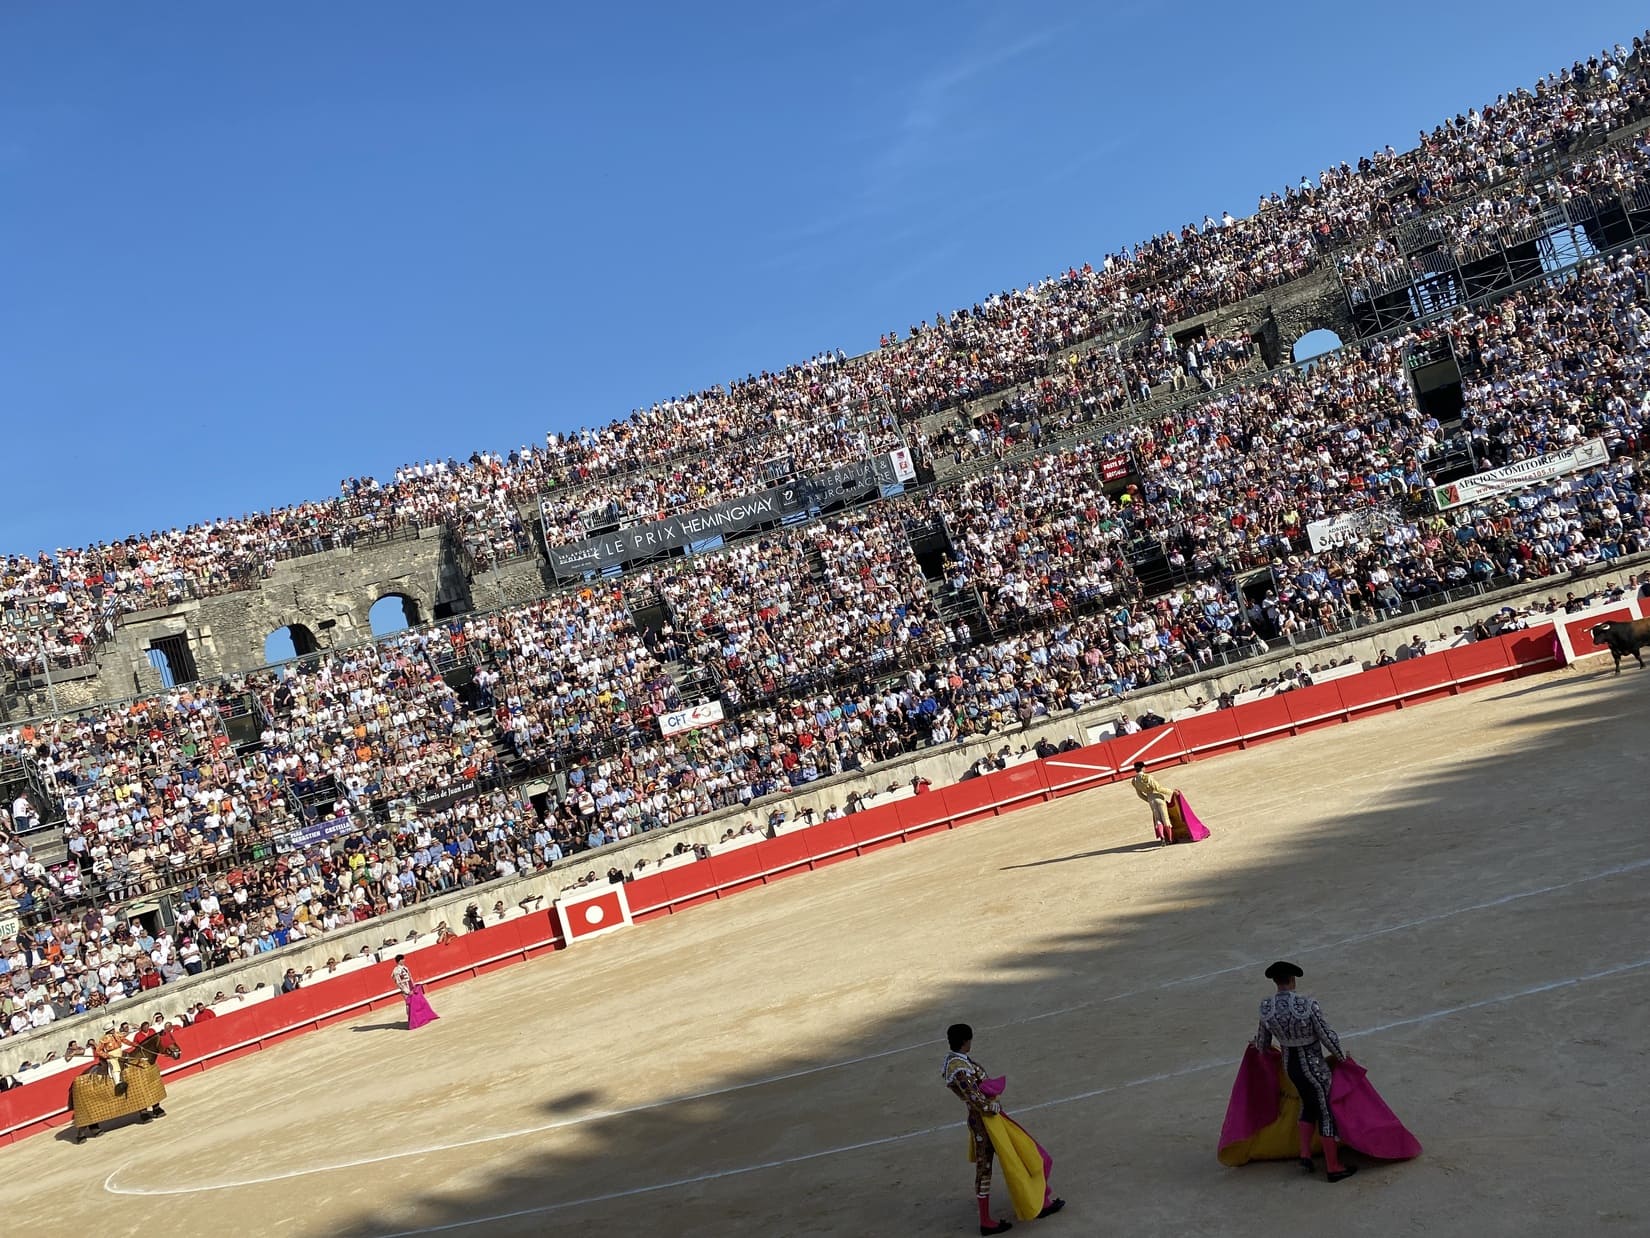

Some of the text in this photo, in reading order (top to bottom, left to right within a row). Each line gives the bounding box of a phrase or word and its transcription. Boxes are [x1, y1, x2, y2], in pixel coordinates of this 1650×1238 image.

[1499, 454, 1556, 477] VOMITOIRE
[606, 497, 773, 556] LE PRIX HEMINGWAY
[440, 789, 448, 798] de
[462, 781, 474, 791] Leal
